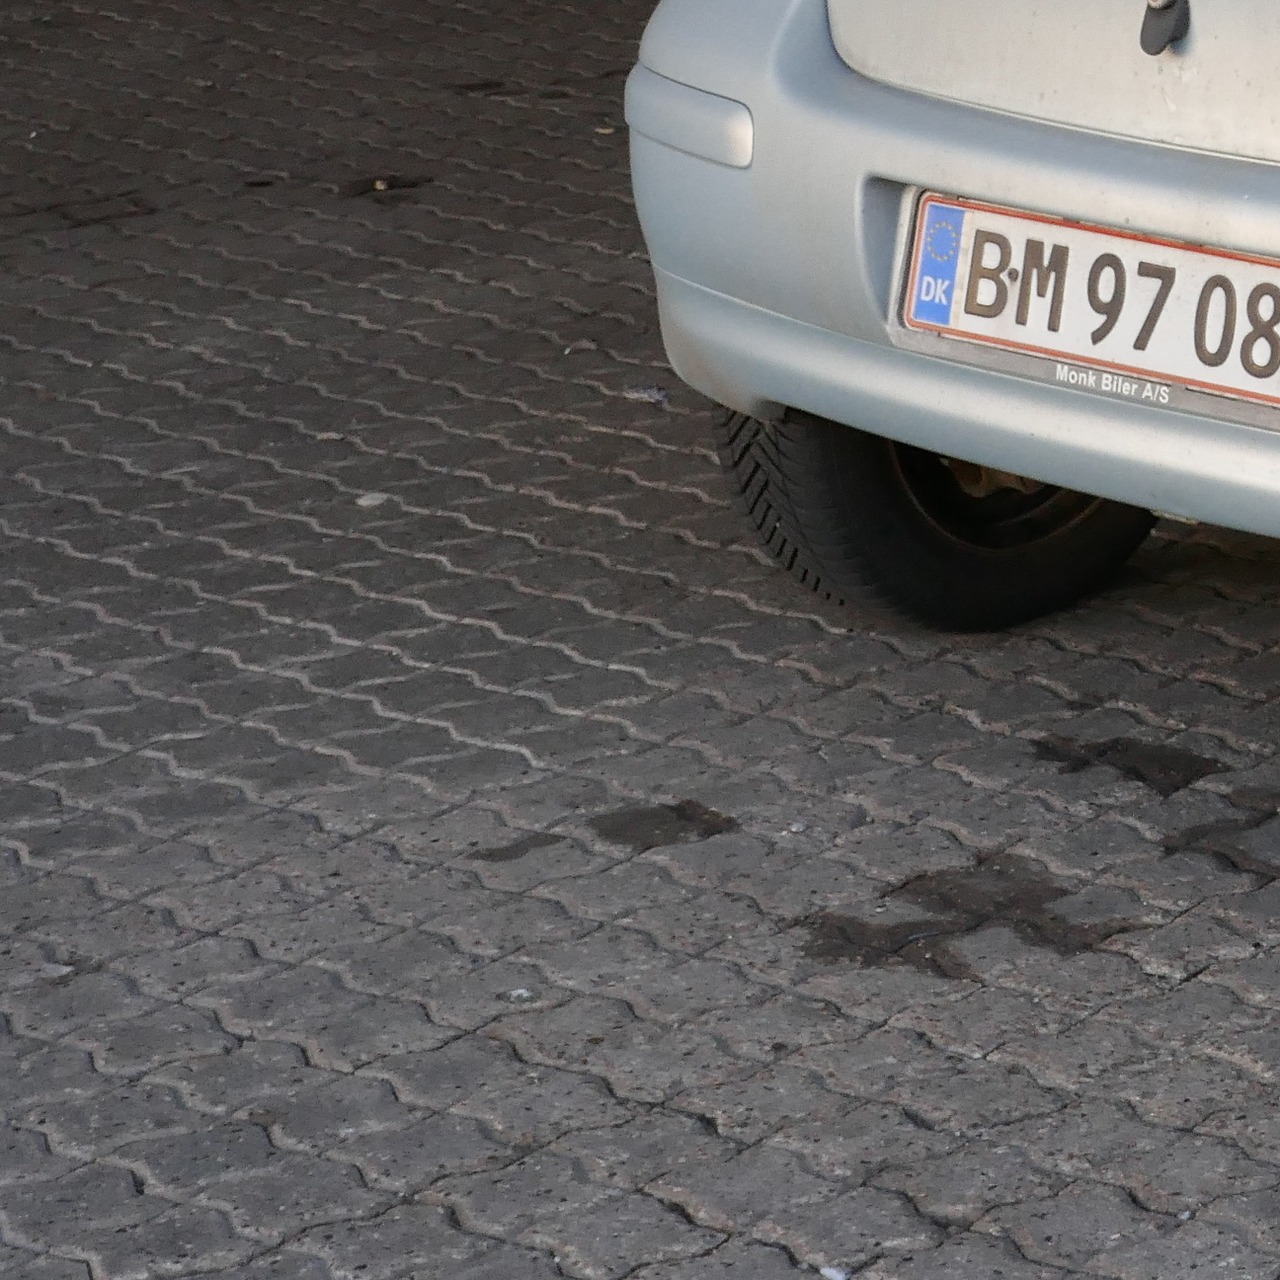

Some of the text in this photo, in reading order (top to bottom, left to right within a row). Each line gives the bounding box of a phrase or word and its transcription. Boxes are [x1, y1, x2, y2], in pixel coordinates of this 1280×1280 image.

[919, 274, 949, 308] DK
[963, 228, 1070, 334] BM
[1086, 252, 1177, 352] 97
[1055, 363, 1170, 404] Monk Biler A/S
